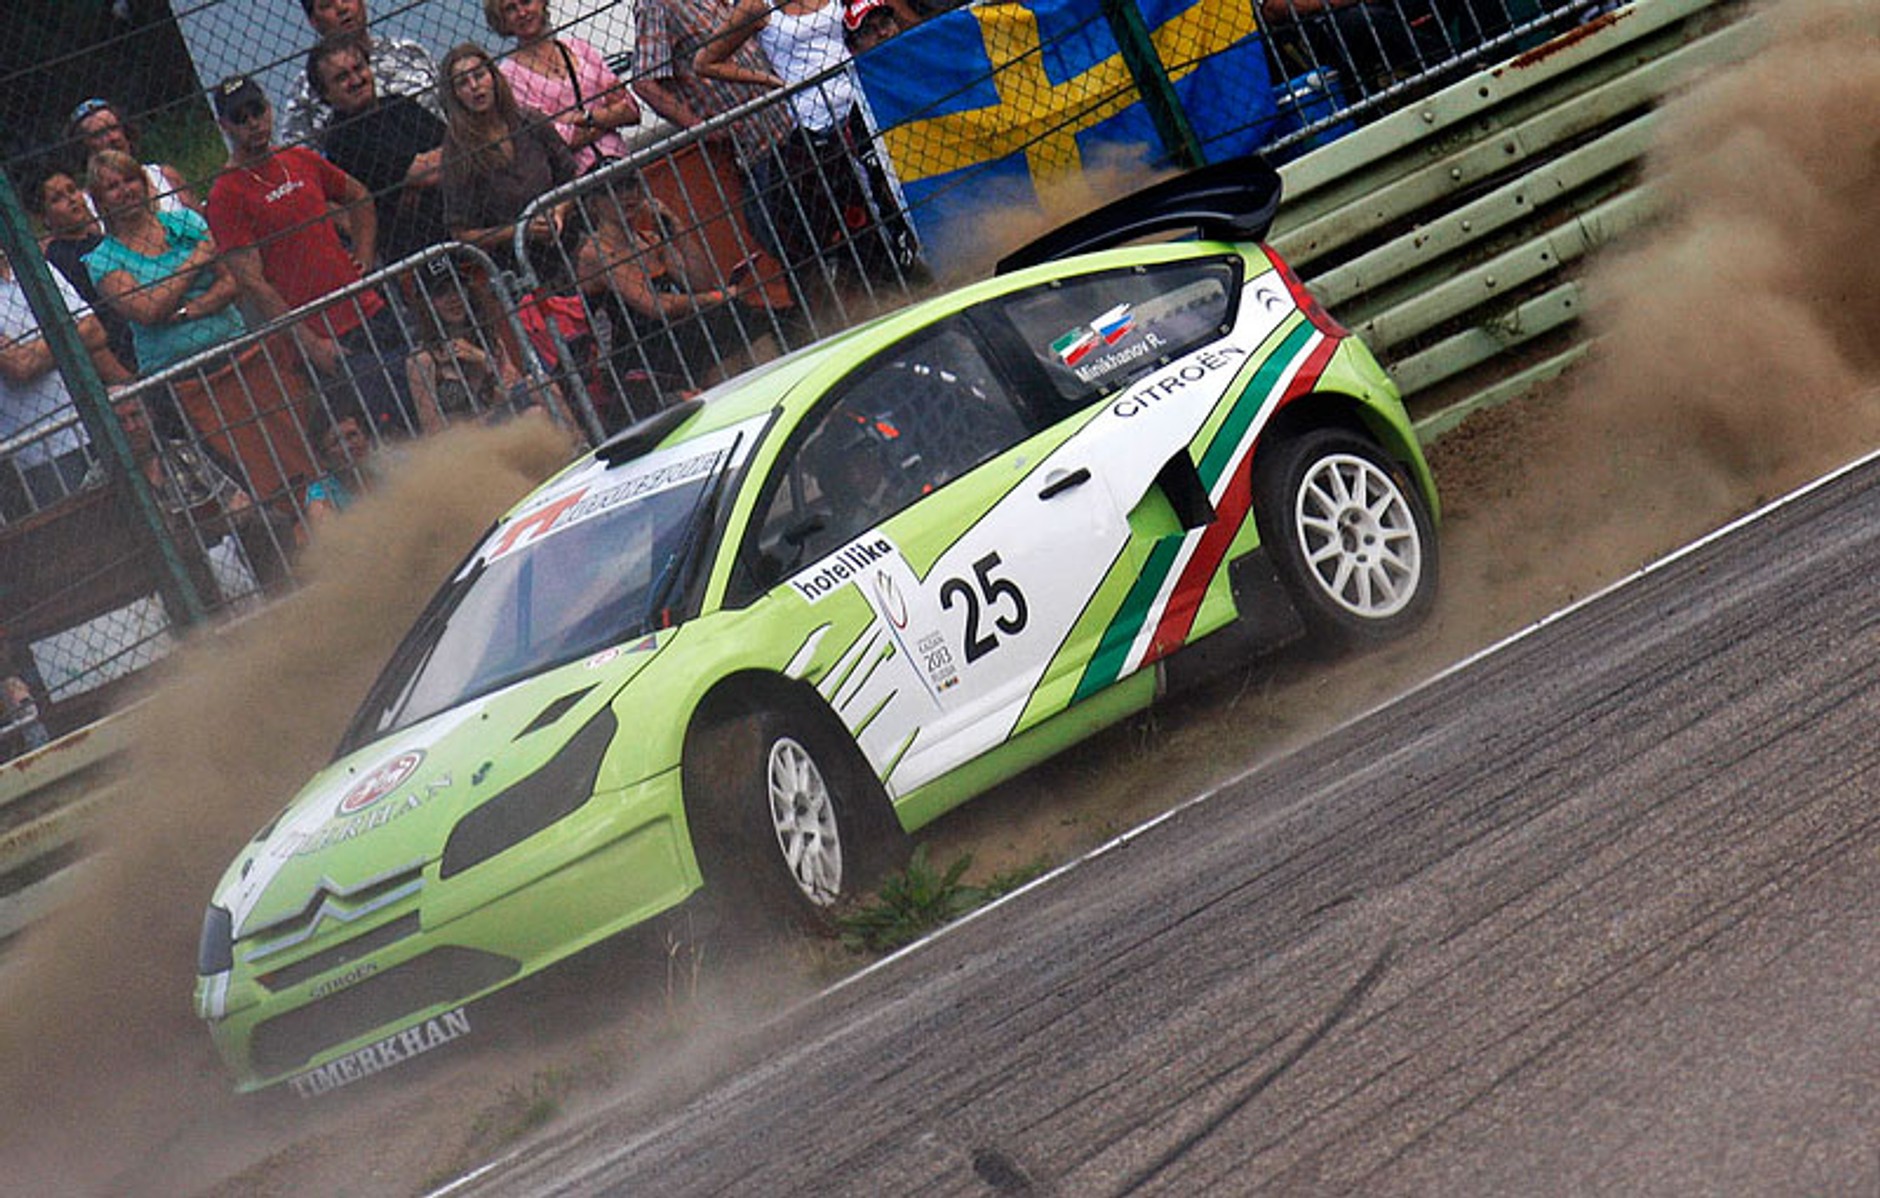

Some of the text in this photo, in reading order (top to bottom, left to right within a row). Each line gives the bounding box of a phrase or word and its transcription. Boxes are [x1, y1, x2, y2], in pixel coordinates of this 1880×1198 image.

[1145, 332, 1167, 349] R.
[1113, 346, 1246, 417] CITROËN
[940, 550, 1028, 664] 25
[924, 645, 953, 673] 2013
[288, 1007, 471, 1099] TIMERKHAN
